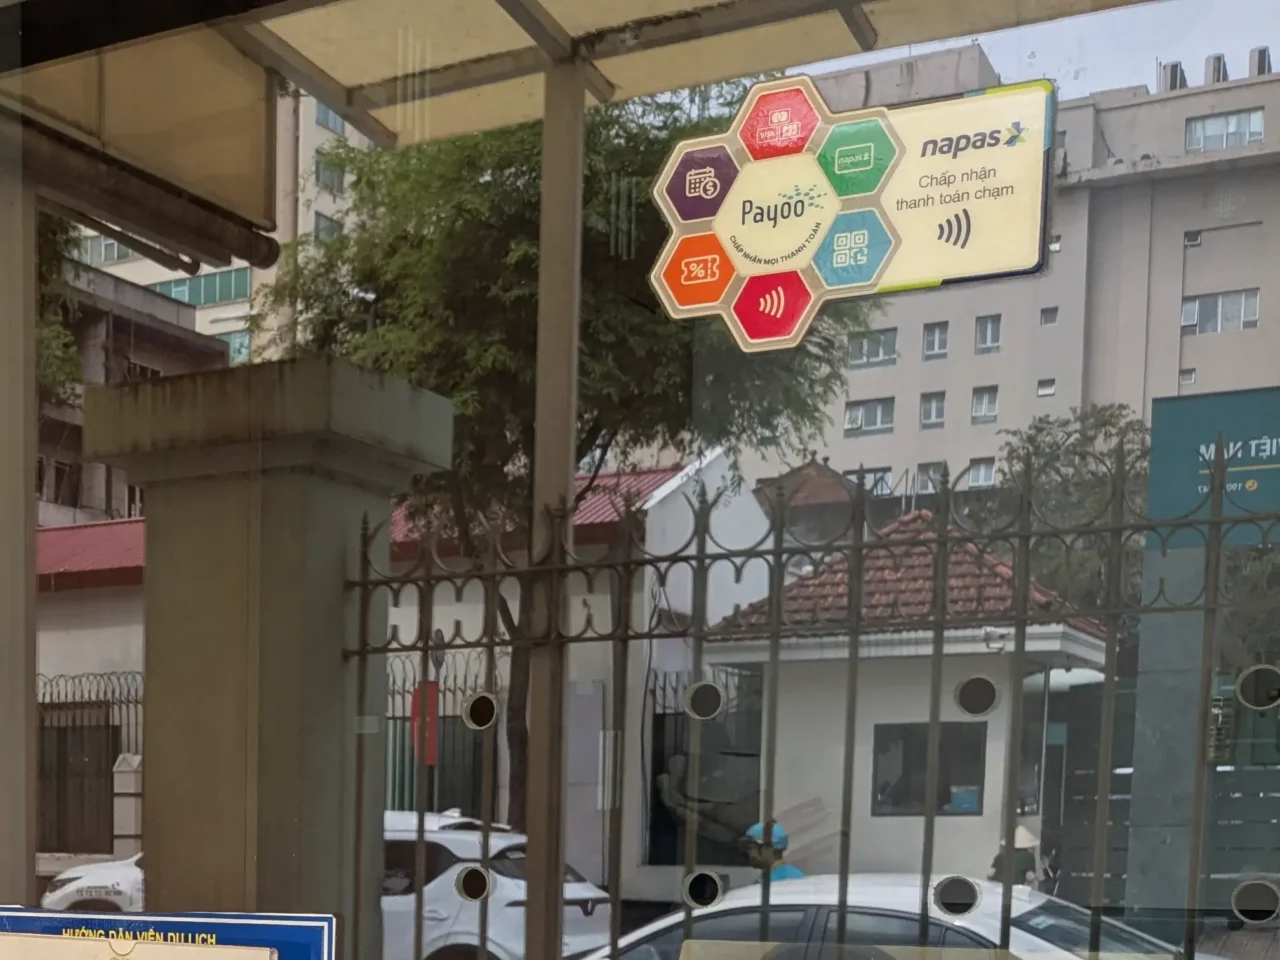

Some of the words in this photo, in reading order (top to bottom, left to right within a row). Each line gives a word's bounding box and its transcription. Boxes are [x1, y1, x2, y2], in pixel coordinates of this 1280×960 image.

[920, 129, 1001, 159] napas
[838, 154, 862, 164] napas
[918, 170, 956, 188] Chấp
[961, 166, 997, 183] nhận
[896, 194, 935, 211] thanh
[939, 190, 970, 205] toán
[974, 185, 1014, 200] chạm
[741, 199, 805, 229] Payoo
[763, 257, 779, 266] MỌI
[780, 243, 807, 263] THANH
